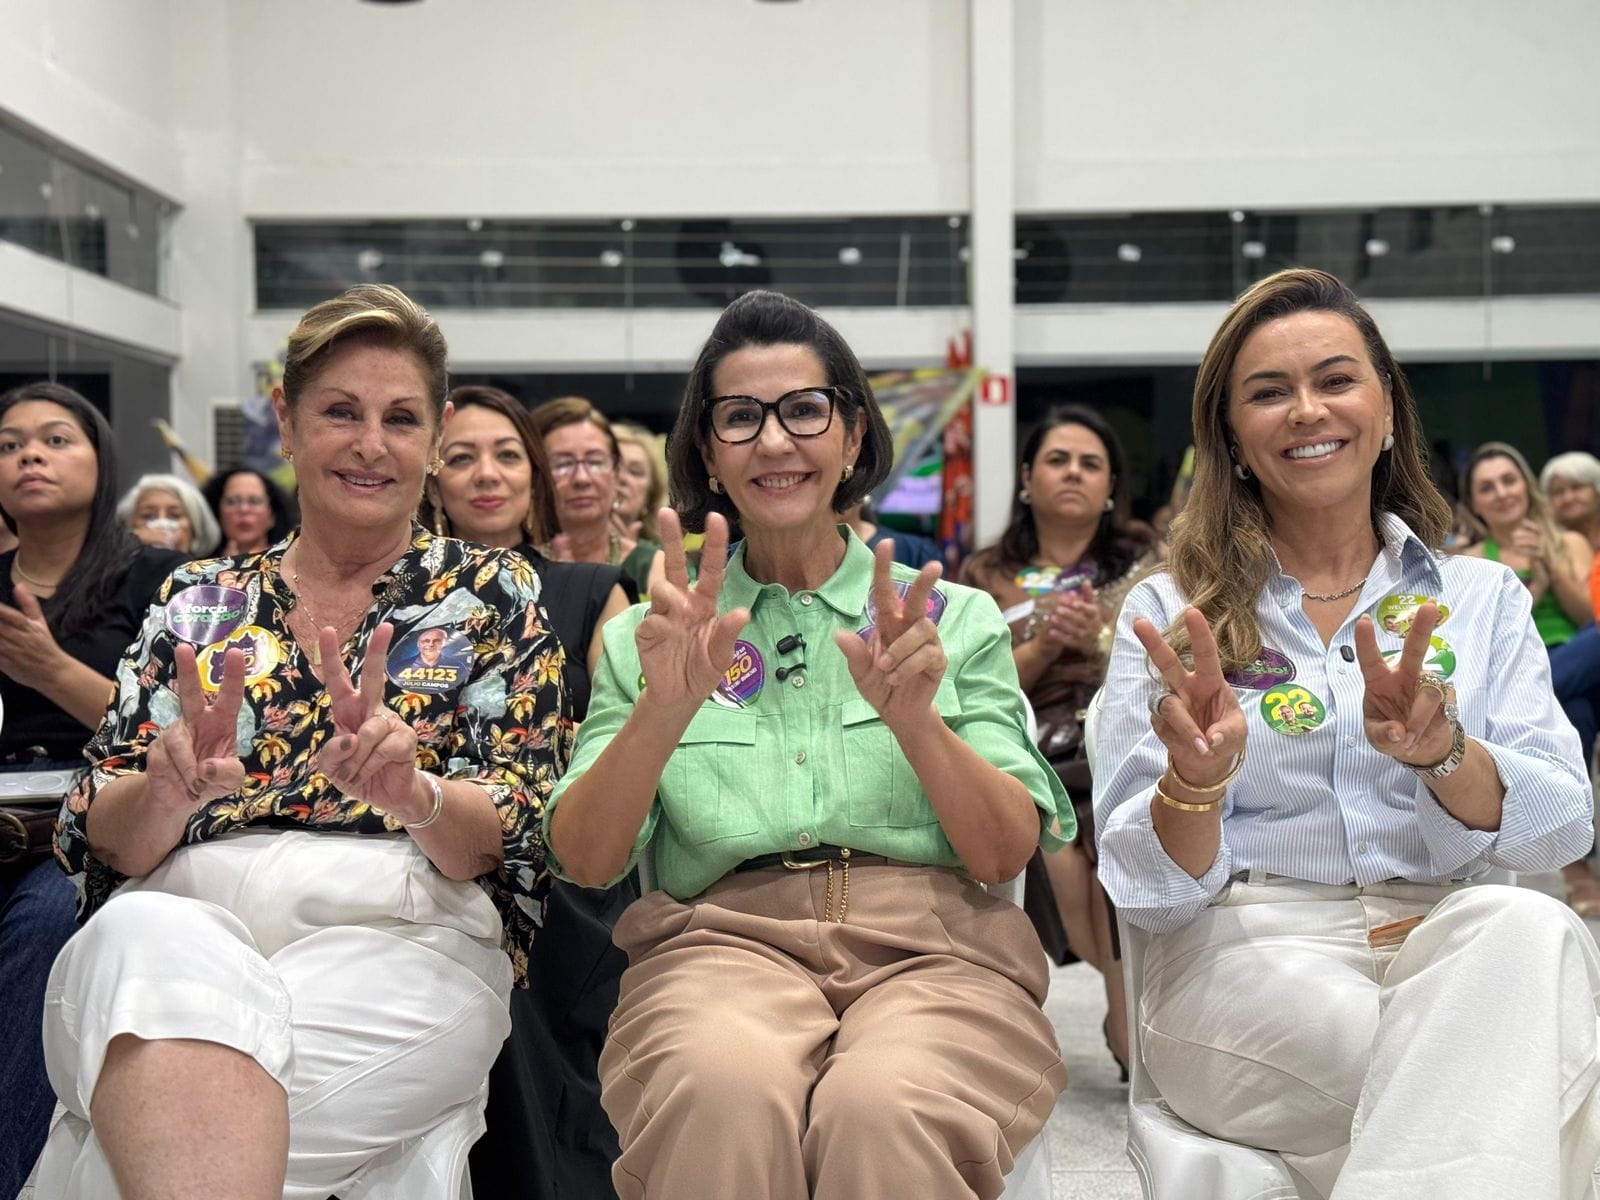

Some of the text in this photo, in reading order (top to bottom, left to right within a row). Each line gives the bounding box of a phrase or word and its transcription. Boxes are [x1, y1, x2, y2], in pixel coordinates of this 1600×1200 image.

[1398, 594, 1416, 605] 22
[398, 667, 457, 682] 44123
[421, 681, 449, 689] CAMPOS
[1265, 688, 1318, 721] 22
